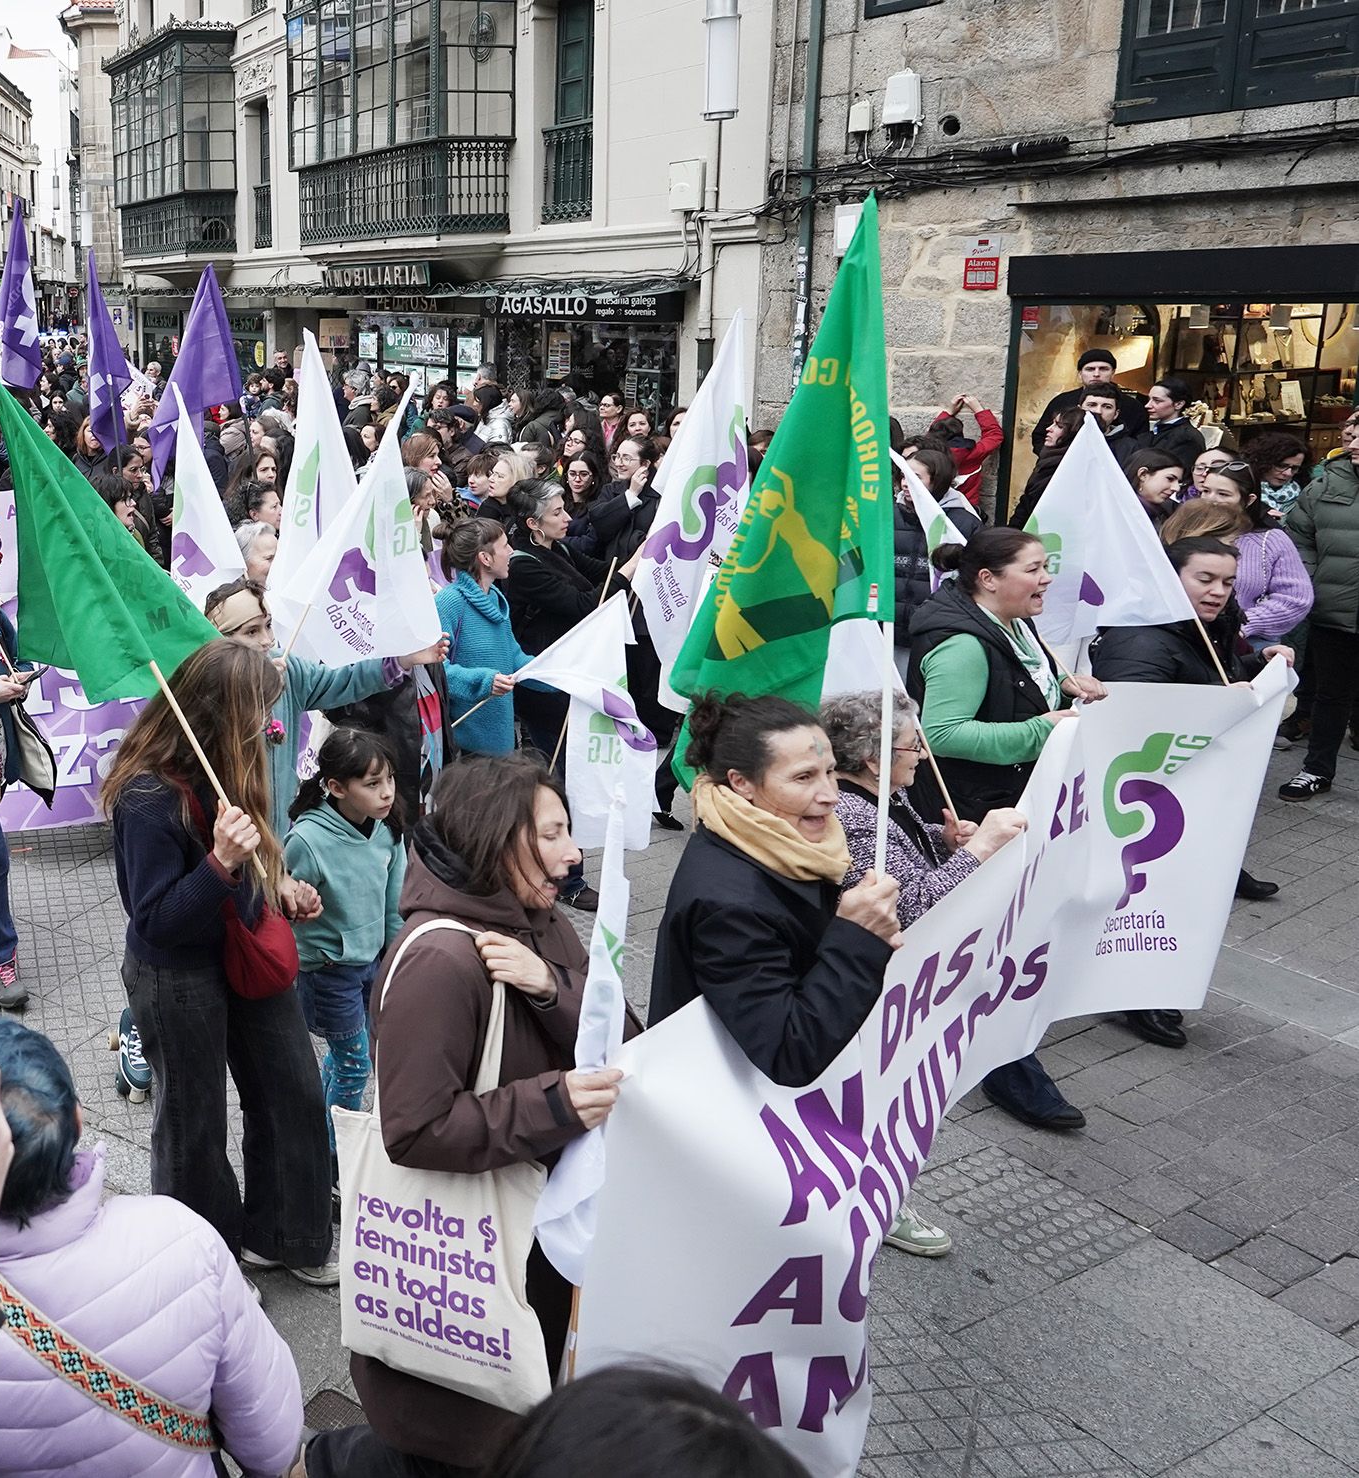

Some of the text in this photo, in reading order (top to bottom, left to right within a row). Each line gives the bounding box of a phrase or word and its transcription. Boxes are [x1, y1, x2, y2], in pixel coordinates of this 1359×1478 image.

[321, 264, 420, 288] INMOBILIARIA
[377, 297, 438, 311] PEDROSA
[500, 296, 588, 316] AGASALLO
[595, 307, 657, 317] regalo souvenirs
[394, 332, 442, 348] PEDROSA
[657, 582, 675, 622] mulleres
[327, 603, 348, 630] das
[1103, 909, 1165, 934] Secretaría
[1095, 931, 1178, 956] das mulleres
[880, 928, 982, 1076] DAS
[358, 1192, 464, 1239] revolta
[355, 1215, 496, 1285] feminista
[354, 1260, 486, 1319] en todas
[355, 1292, 512, 1361] as aldeas!
